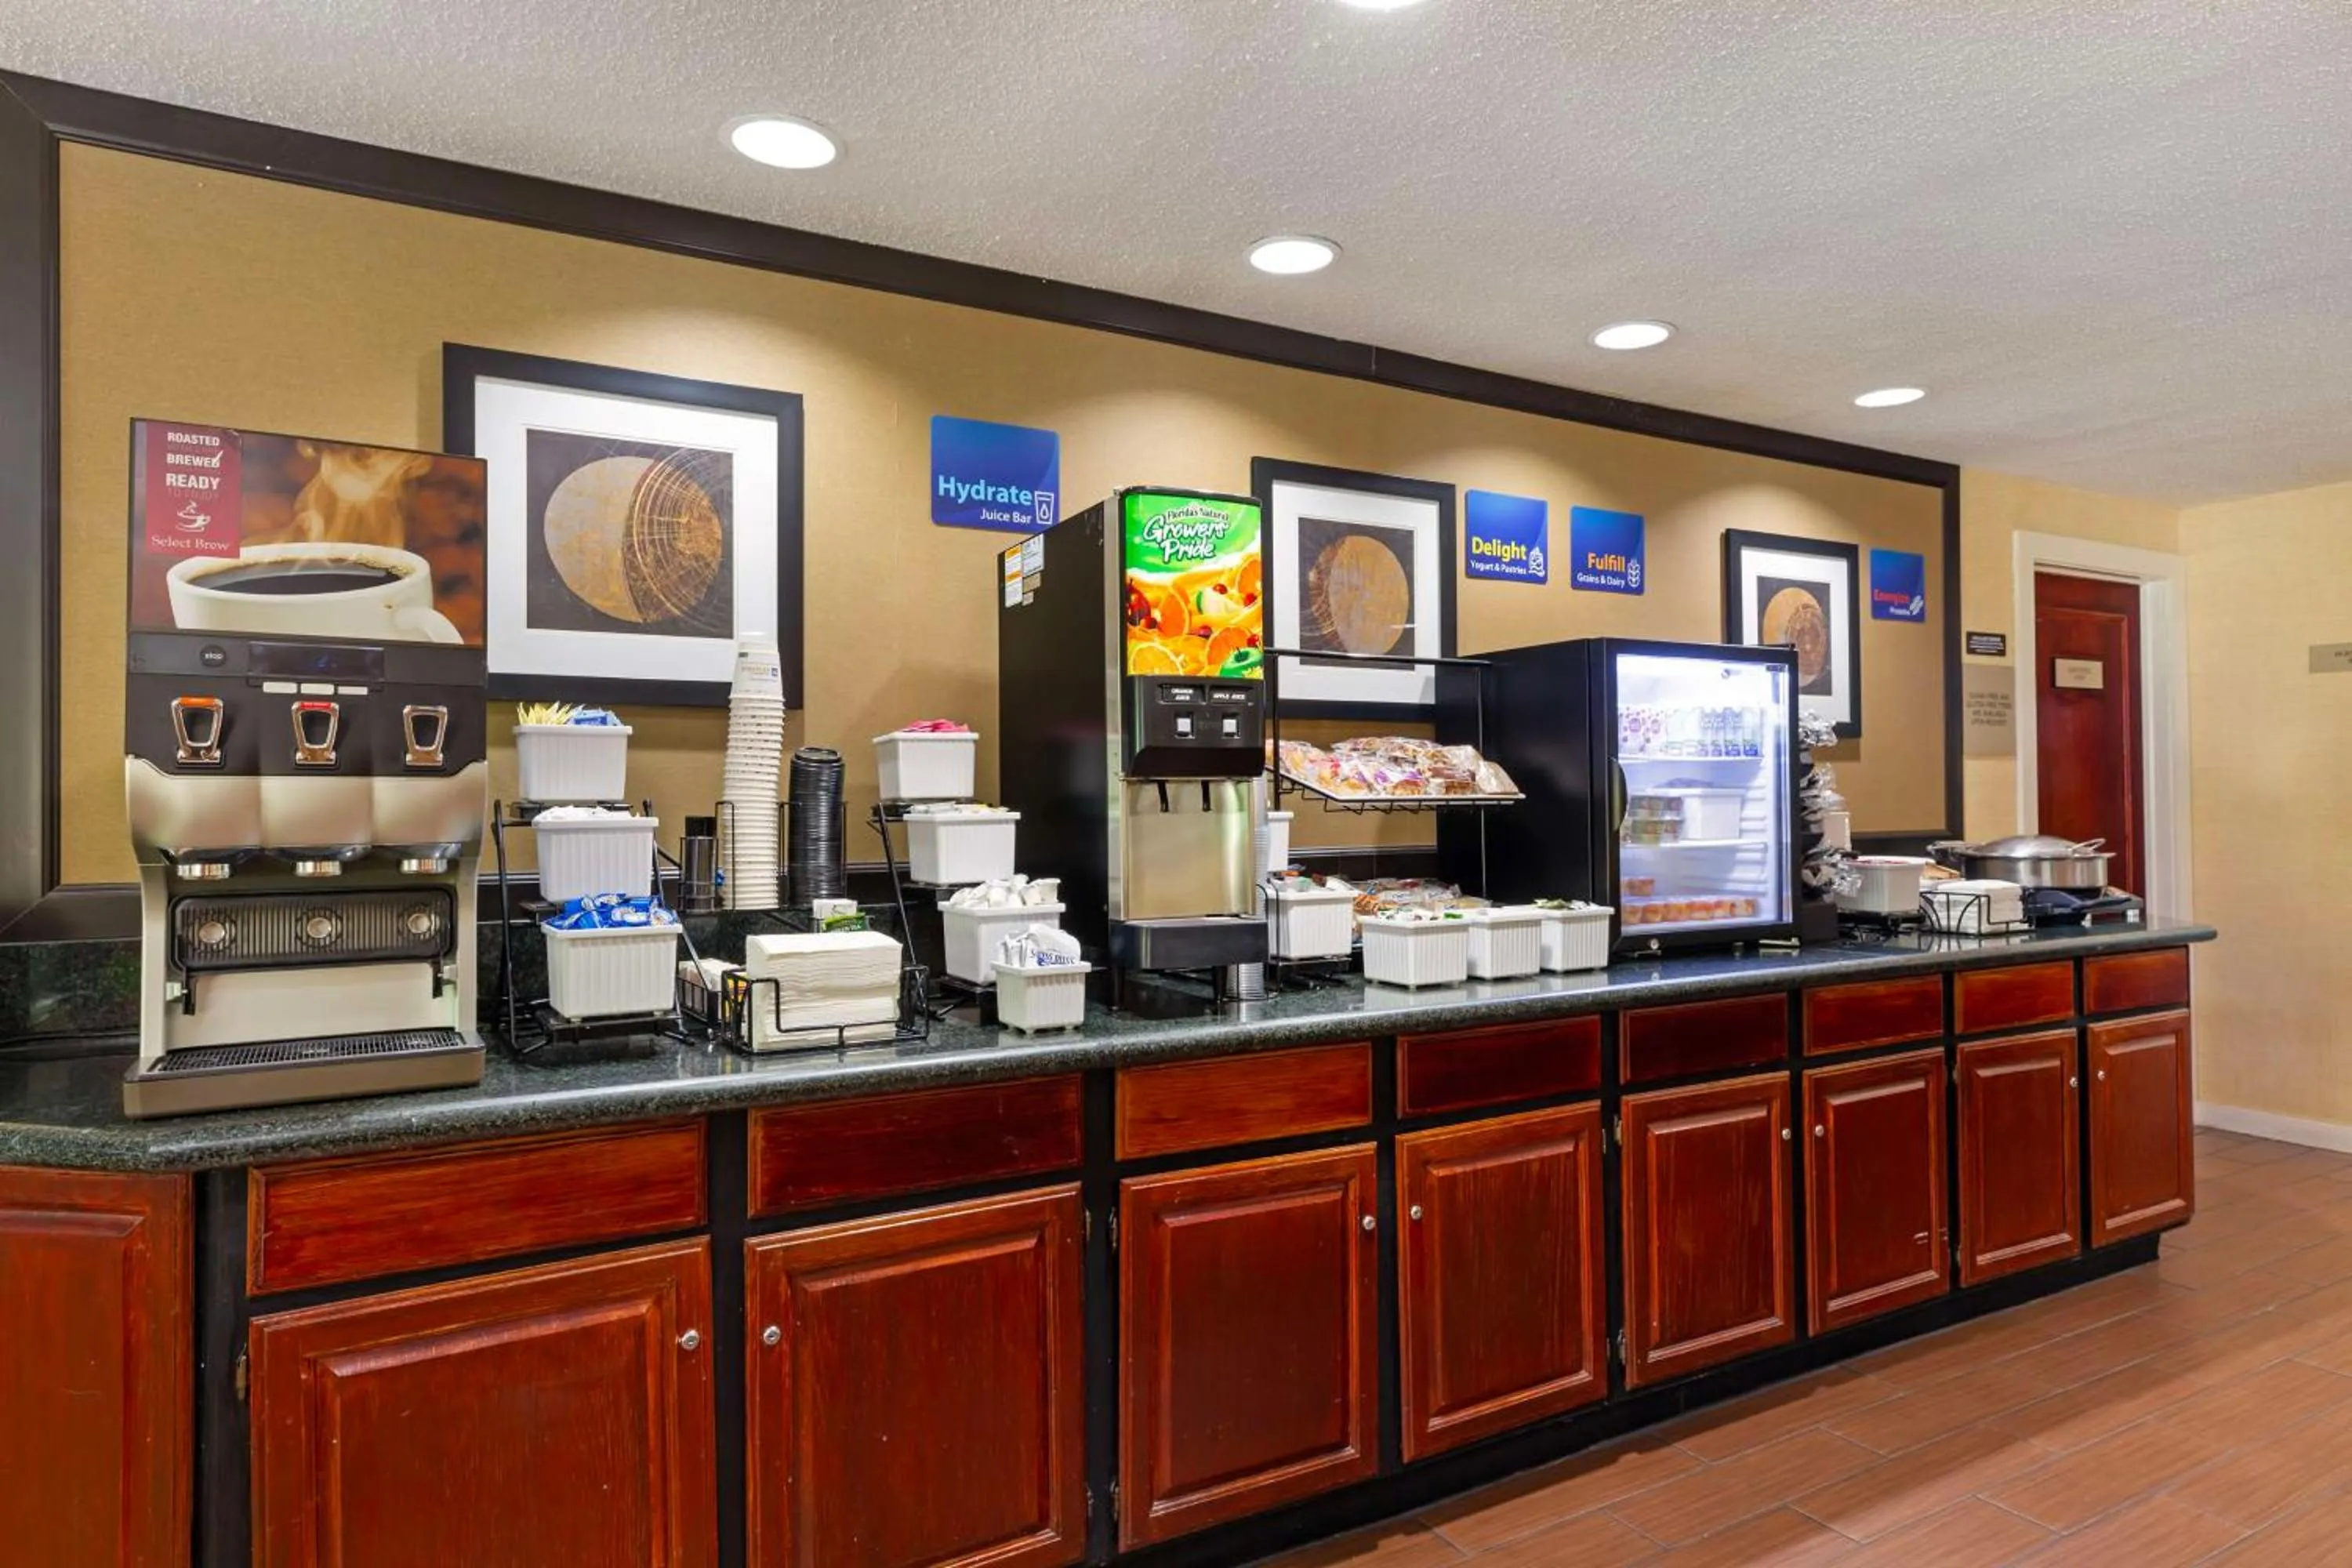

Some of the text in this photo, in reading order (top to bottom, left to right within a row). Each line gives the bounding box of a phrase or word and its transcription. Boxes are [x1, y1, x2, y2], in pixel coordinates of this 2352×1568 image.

[167, 432, 220, 446] ROASTED
[166, 452, 220, 469] BREWED
[165, 473, 220, 490] READY
[938, 475, 1033, 506] Hydrate
[979, 508, 1032, 524] Juice Bar
[151, 534, 230, 550] Select Brew
[1160, 537, 1217, 564] Pride
[1472, 536, 1527, 562] Delight
[1470, 559, 1494, 572] Yogurt
[1588, 552, 1625, 572] Fulfill
[1577, 572, 1599, 584] Grains
[1606, 575, 1625, 588] Dairy
